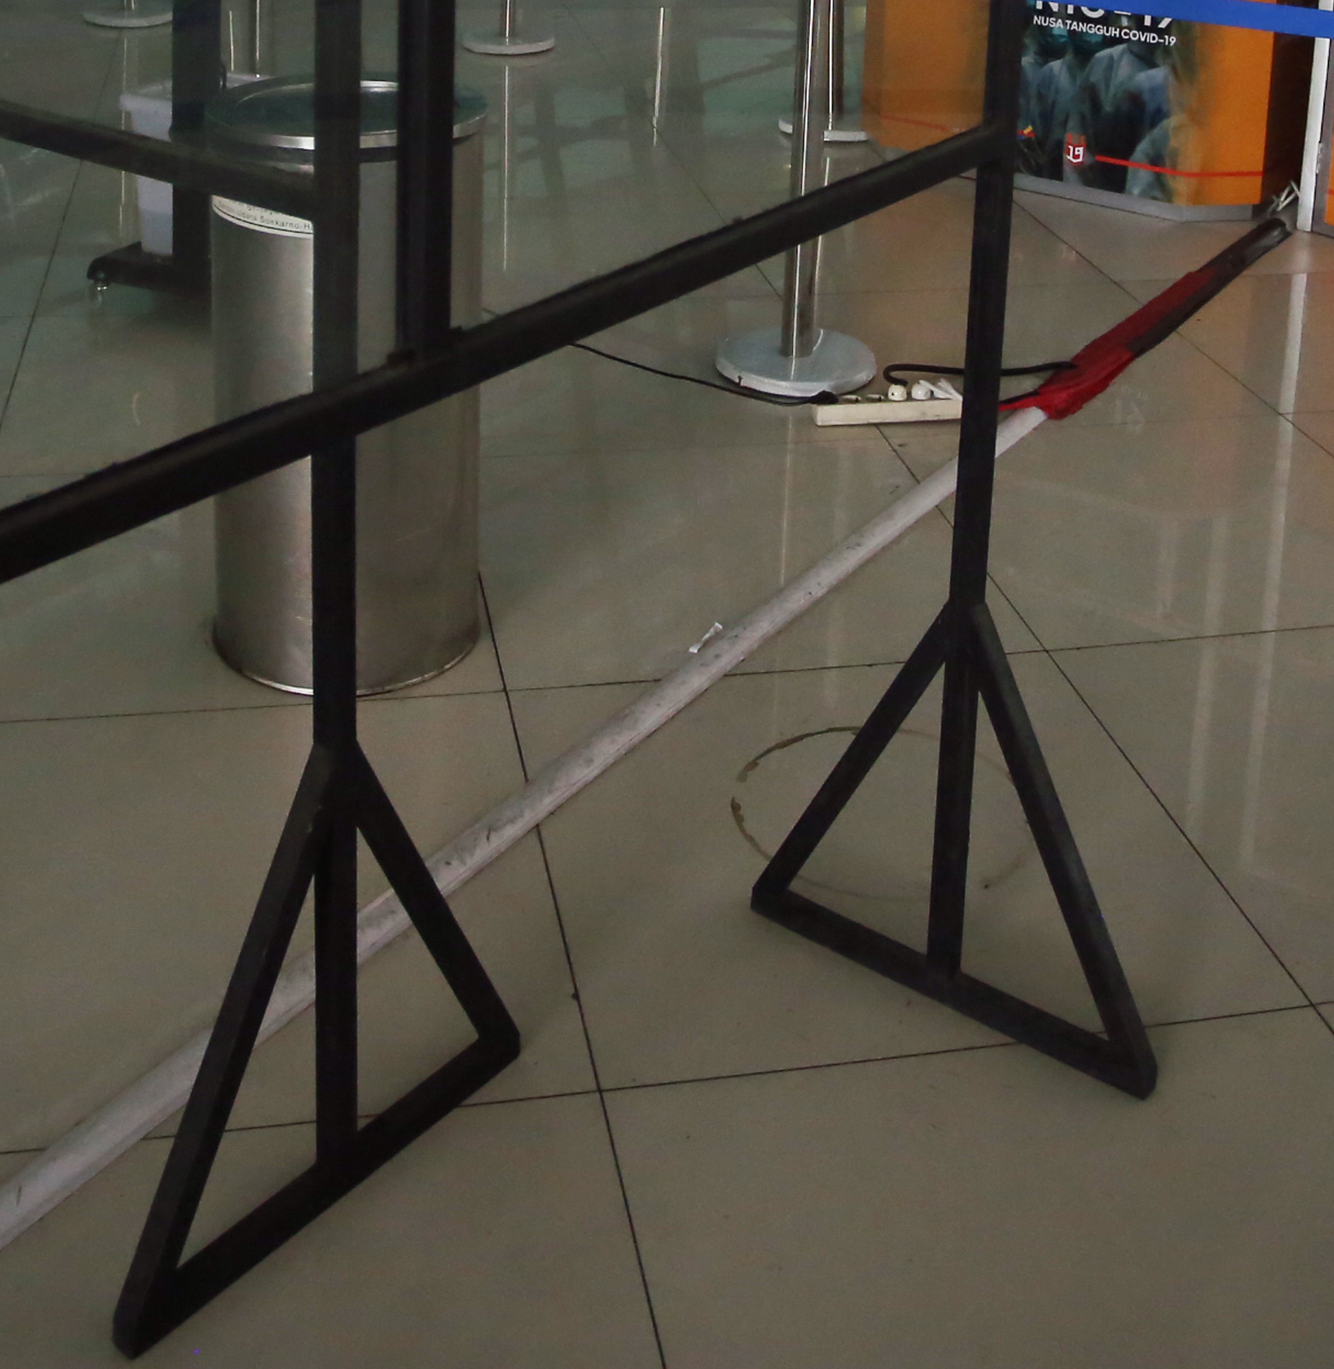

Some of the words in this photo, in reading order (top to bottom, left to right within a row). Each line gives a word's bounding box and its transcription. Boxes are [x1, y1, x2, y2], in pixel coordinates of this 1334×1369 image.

[1033, 15, 1064, 28] NUSA
[1065, 20, 1120, 38] TANGGUH
[1121, 29, 1177, 47] COVID-19
[260, 215, 312, 229] Soekarno-H
